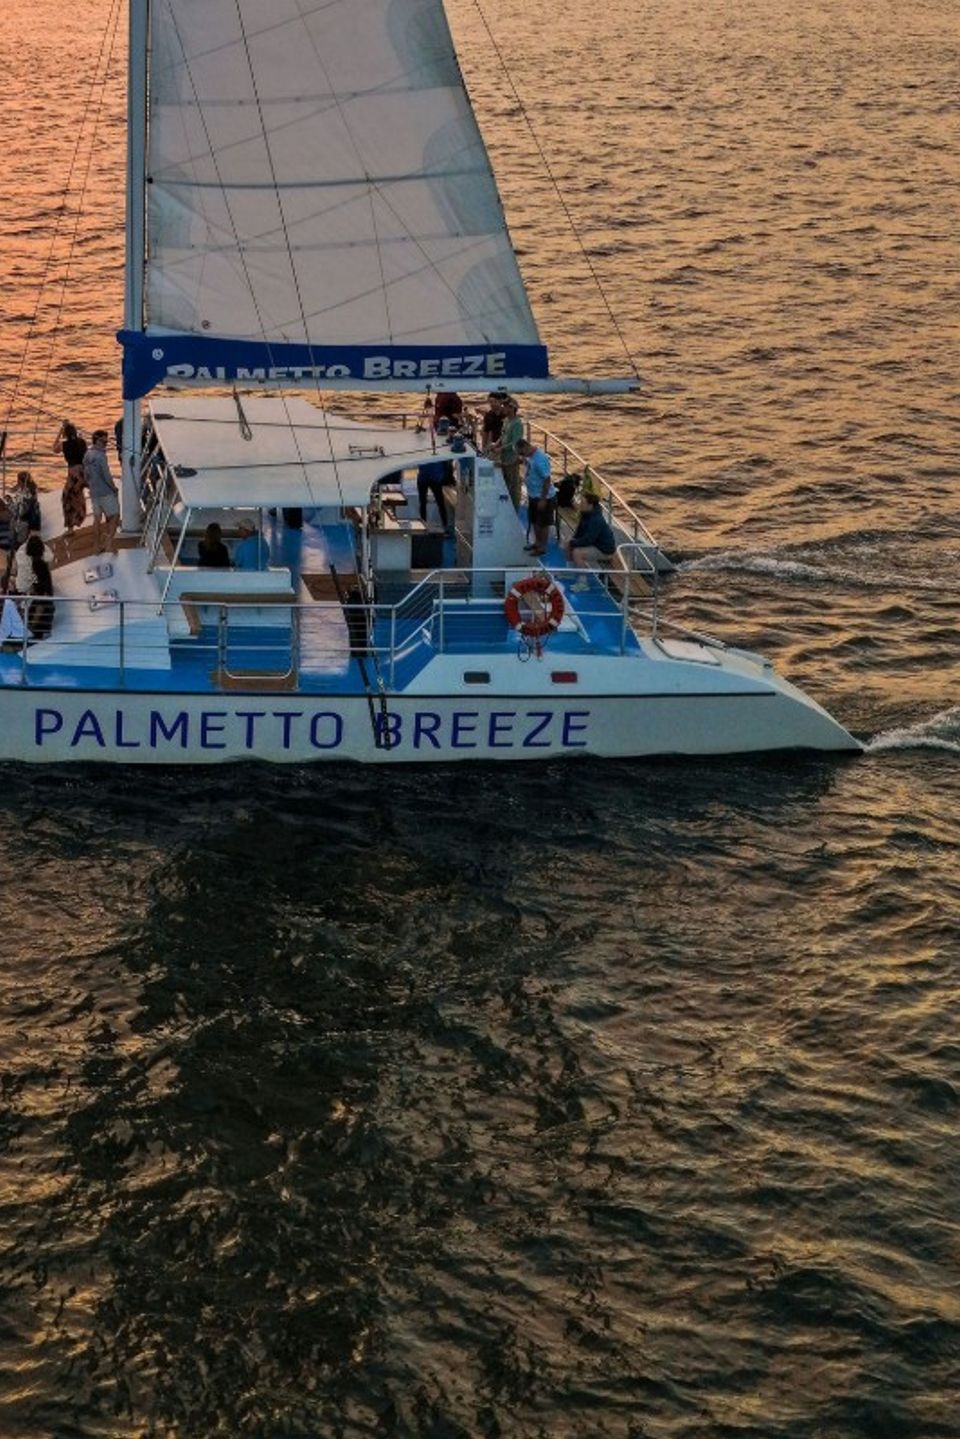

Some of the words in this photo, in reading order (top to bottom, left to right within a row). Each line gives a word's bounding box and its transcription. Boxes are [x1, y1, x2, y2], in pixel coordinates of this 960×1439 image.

[363, 352, 507, 379] BREEZE
[33, 708, 345, 750] PALMETTO
[375, 711, 591, 750] BREEZE
